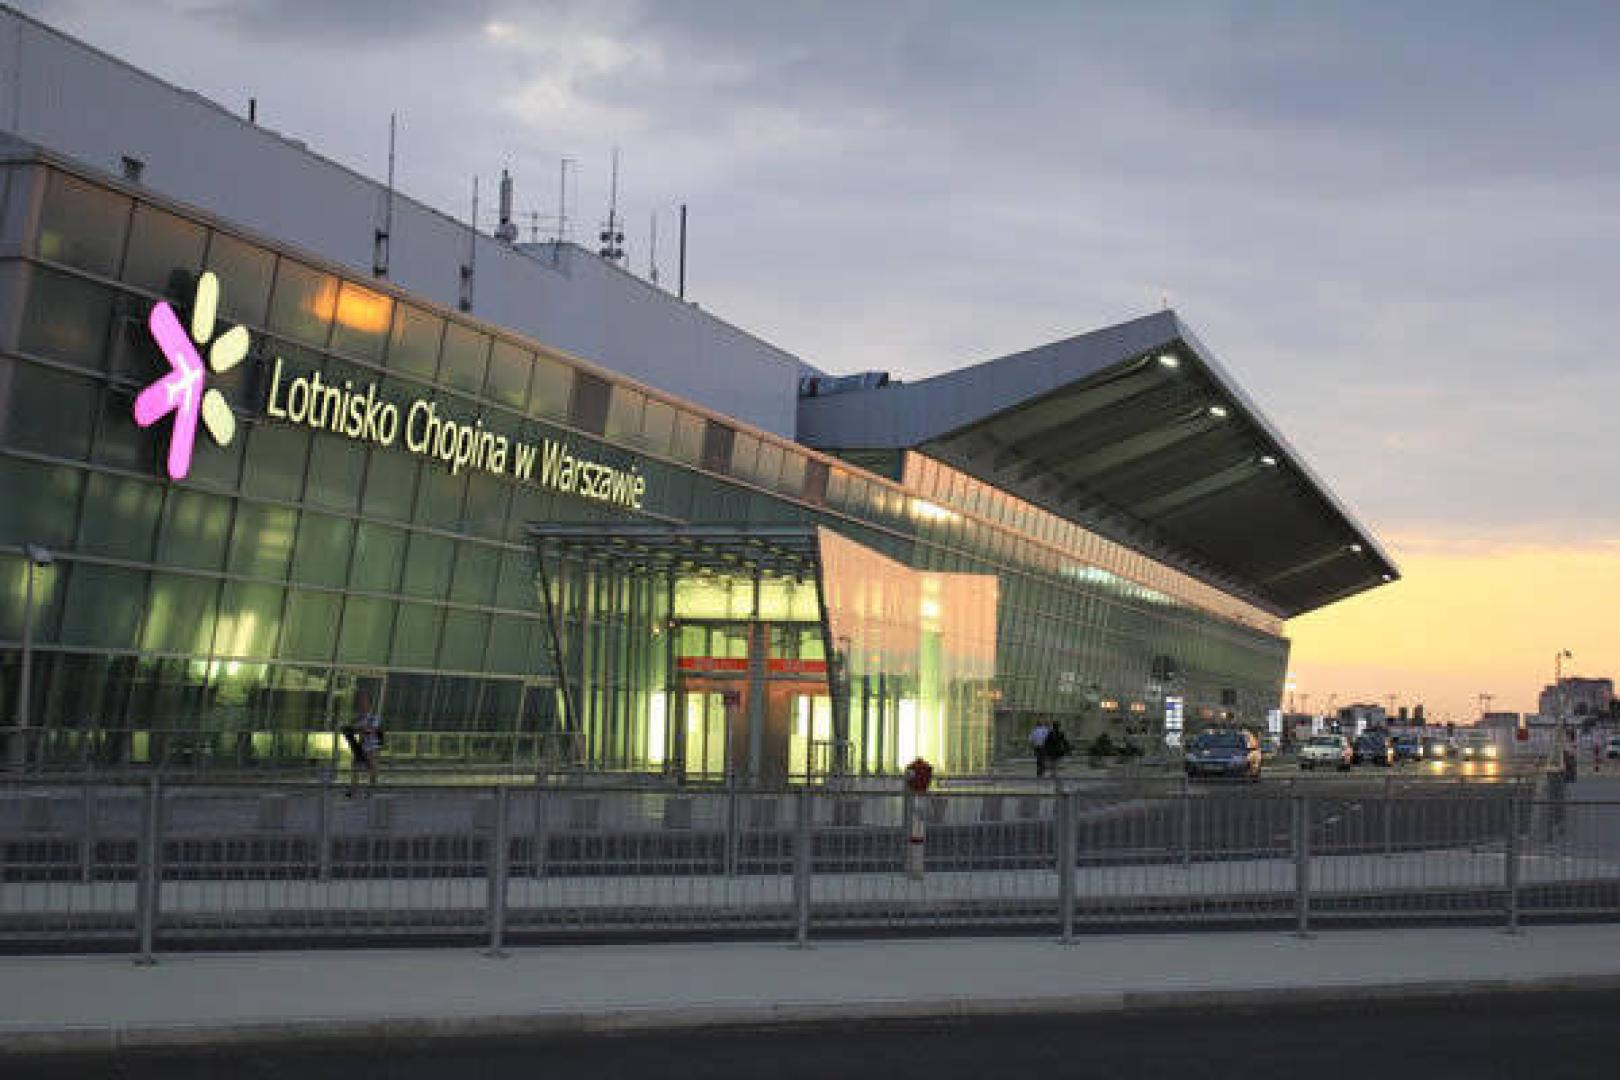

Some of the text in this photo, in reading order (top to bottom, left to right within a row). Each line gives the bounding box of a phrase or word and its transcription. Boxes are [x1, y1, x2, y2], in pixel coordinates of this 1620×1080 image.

[266, 356, 646, 509] Lotnisko Chopina w Warszawie
